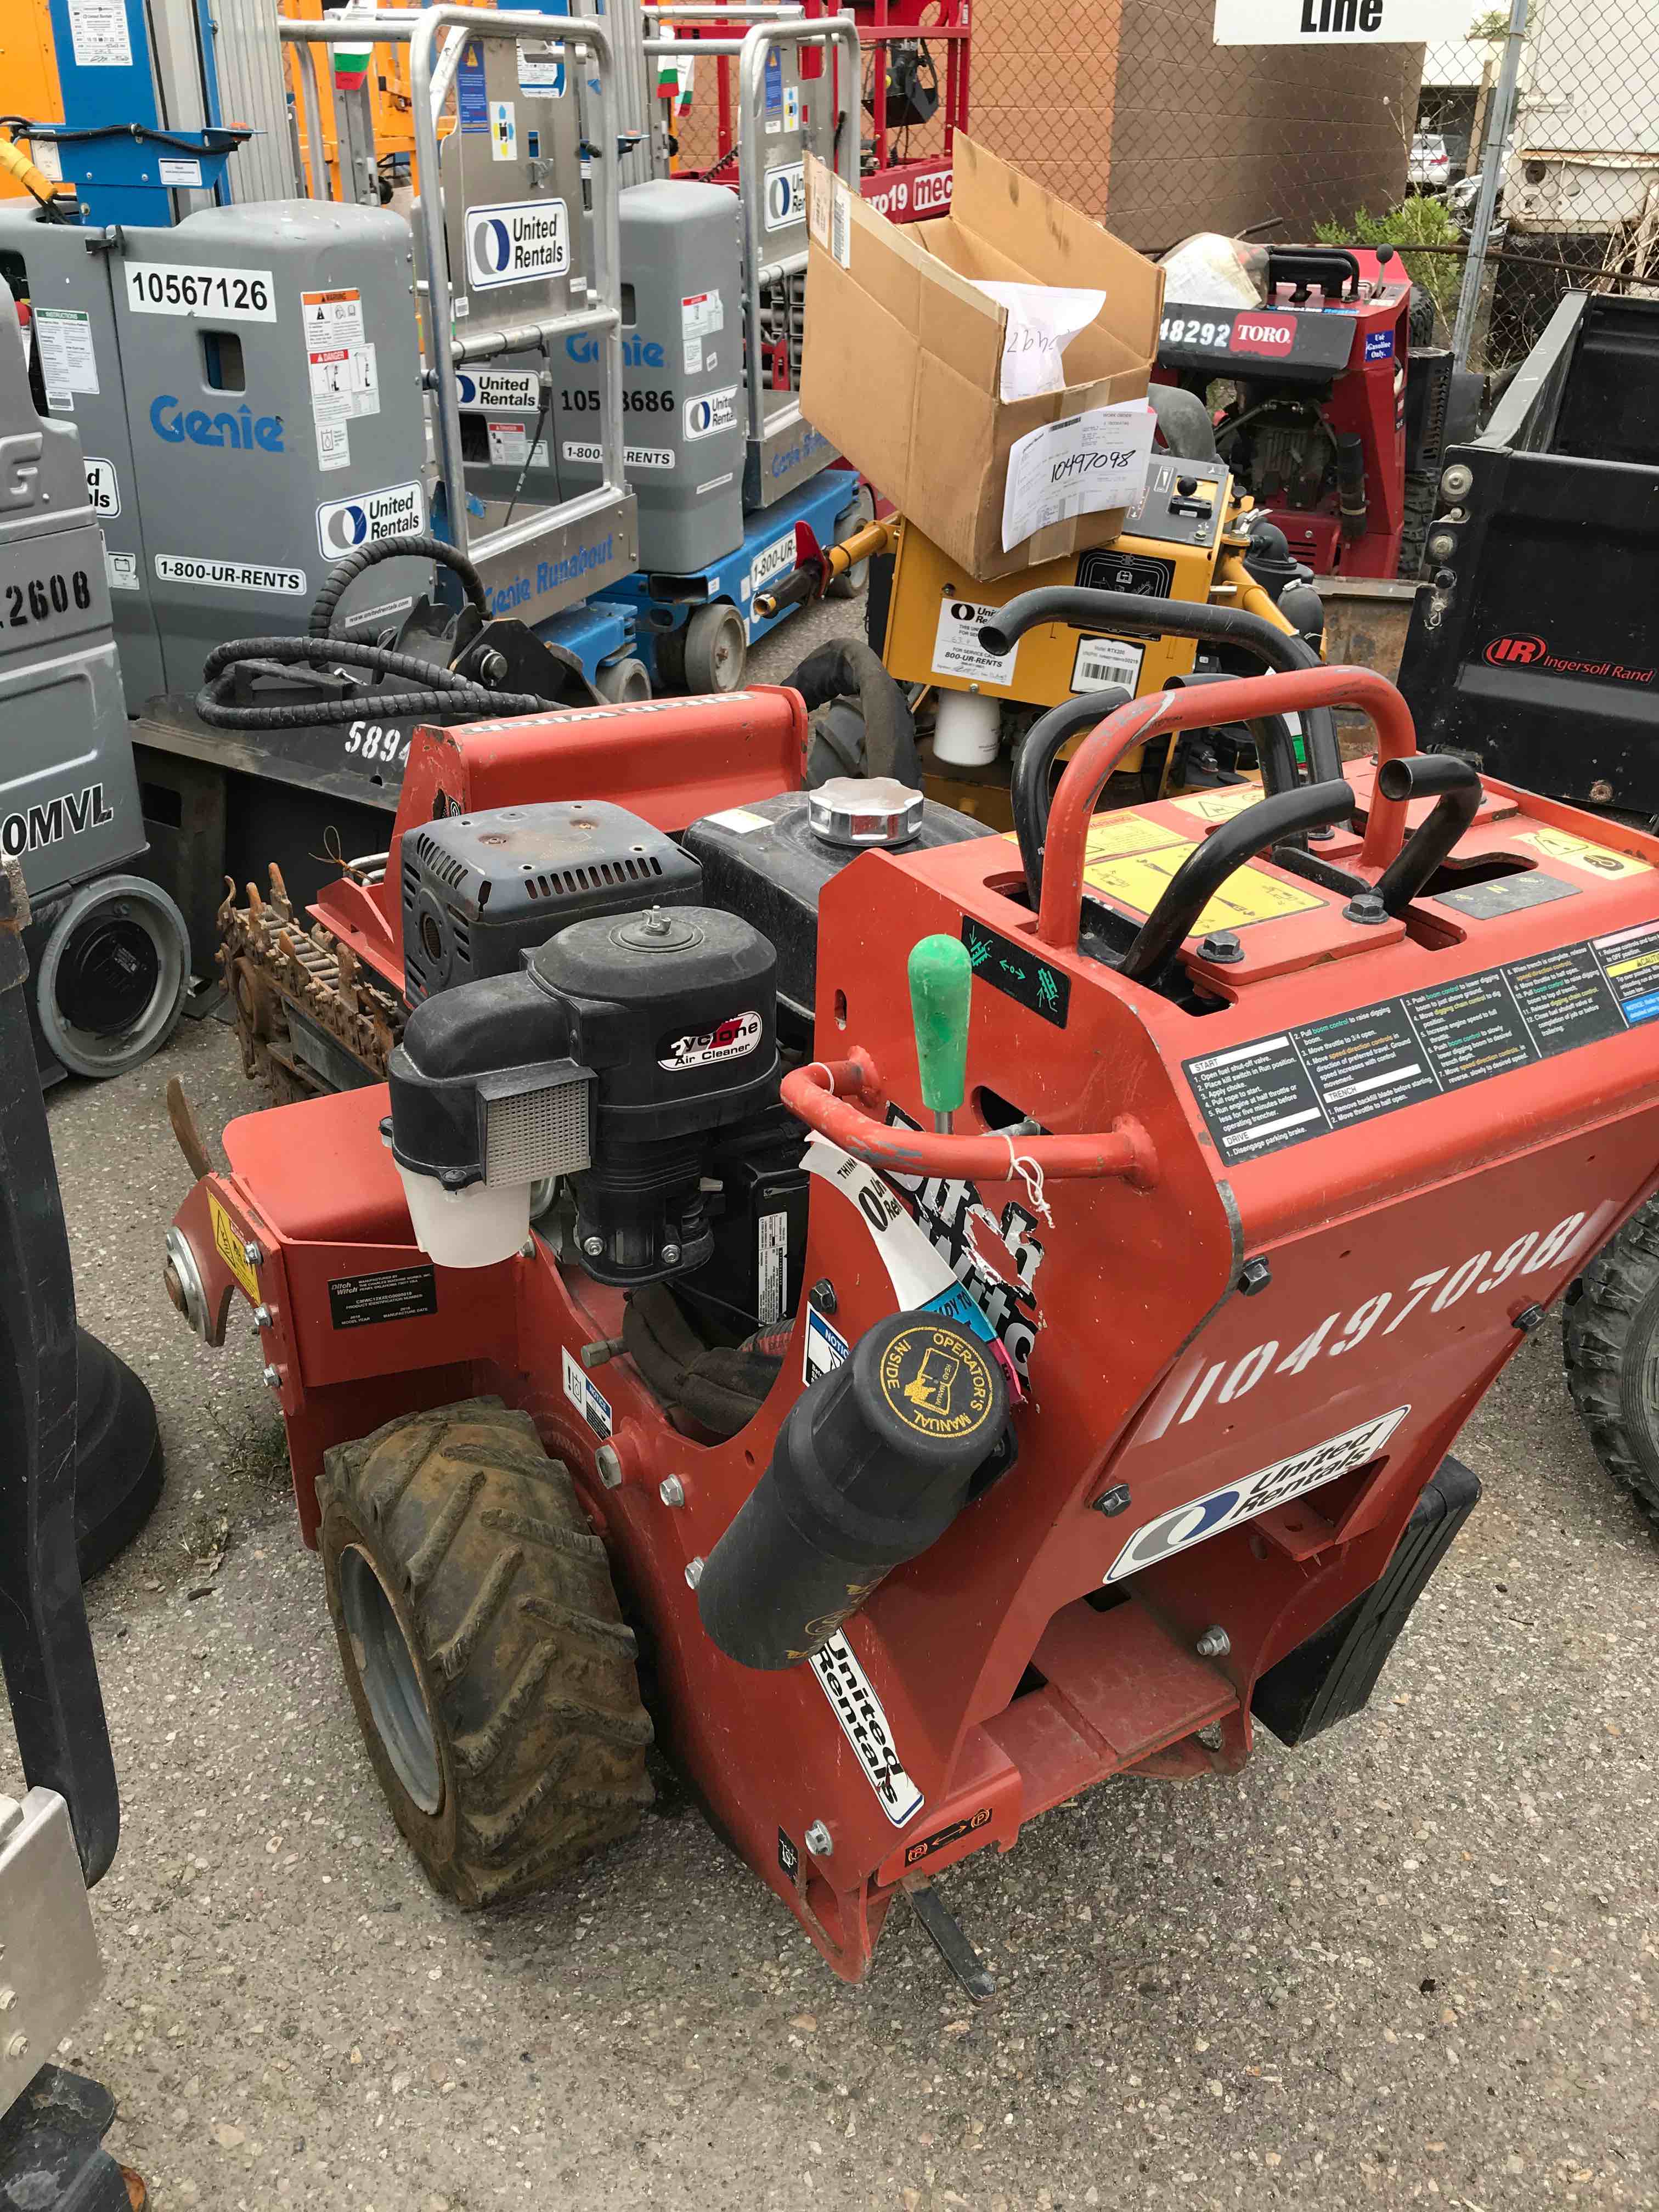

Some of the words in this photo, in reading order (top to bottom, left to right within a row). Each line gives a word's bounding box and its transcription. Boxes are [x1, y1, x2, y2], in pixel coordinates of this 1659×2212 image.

[1300, 0, 1383, 33] Line
[513, 214, 557, 242] United
[515, 240, 563, 269] Rentals
[132, 271, 268, 311] 10567126
[1237, 324, 1290, 344] TORO
[1368, 341, 1391, 351] Gasoline
[322, 350, 345, 361] DANGER
[1371, 351, 1386, 359] Only.
[479, 376, 529, 391] United
[480, 391, 535, 406] Rentals
[712, 396, 733, 411] Unit
[150, 394, 285, 453] Genie
[712, 411, 736, 426] Renta
[567, 447, 670, 465] 1-800--RENTS
[1051, 449, 1136, 483] 10497098
[369, 492, 415, 522] United
[371, 510, 419, 540] Rentals
[536, 533, 614, 594] Runabout
[754, 539, 795, 580] 1-800-UR-
[160, 560, 300, 590] 1-800-UR-RENTS
[0, 571, 91, 628] 2608
[977, 607, 996, 617] Uni
[945, 651, 1003, 668] 800-UR-RENTS
[1495, 639, 1536, 663] IR
[1542, 655, 1609, 678] Ingersoll
[1610, 664, 1654, 683] Rand
[623, 694, 752, 714] Ditch
[674, 1020, 758, 1053] yclone
[1303, 1035, 1322, 1045] boom.
[675, 1054, 696, 1066] Air
[702, 1042, 751, 1060] Cleaner
[1194, 1058, 1220, 1071] START
[1199, 1070, 1218, 1082] Open
[1217, 1066, 1231, 1076] fuel
[1229, 1059, 1254, 1072] shut-off
[1252, 1054, 1271, 1065] valve.
[1204, 1079, 1222, 1090] Place
[1221, 1076, 1232, 1084] kill
[1231, 1069, 1251, 1081] switch
[1257, 1063, 1271, 1073] Run
[1271, 1056, 1297, 1070] position.
[1323, 1074, 1354, 1088] movement.
[1207, 1087, 1227, 1099] Apply
[1226, 1081, 1246, 1092] choke.
[1211, 1097, 1224, 1107] Pull
[1223, 1092, 1240, 1103] rope
[1245, 1085, 1262, 1095] start.
[1215, 1105, 1229, 1115] Run
[1228, 1099, 1250, 1111] engine
[1256, 1092, 1269, 1102] half
[1267, 1086, 1290, 1098] throttle
[1328, 1086, 1357, 1100] TRENCH
[1333, 1101, 1357, 1113] Remove
[1356, 1093, 1378, 1105] backfill
[1377, 1088, 1393, 1098] blade
[1392, 1082, 1412, 1093] before
[1218, 1114, 1233, 1123] less
[1232, 1110, 1242, 1119] for
[1241, 1107, 1254, 1116] five
[1253, 1099, 1278, 1112] minutes
[1277, 1093, 1297, 1104] before
[1222, 1117, 1252, 1133] operating
[1251, 1108, 1279, 1122] trencher.
[1226, 1132, 1249, 1144] DRIVE
[1232, 1139, 1266, 1156] Disengage
[1264, 1131, 1289, 1146] parking
[1287, 1125, 1307, 1137] brake.
[331, 1282, 351, 1290] Ditch
[337, 1286, 358, 1295] Witch
[368, 1297, 403, 1307] IDENTIFICATION
[383, 1310, 416, 1318] MANUFACTURE
[934, 1298, 960, 1317] ADY
[957, 1291, 973, 1311] TO
[1178, 1212, 1586, 1424] 10497098
[825, 1329, 850, 1359] NOTIC
[886, 1339, 912, 1390] INSIDE
[933, 1332, 986, 1412] OPERATOR'S
[589, 1385, 607, 1412] NOTICE
[913, 1408, 973, 1432] MANUAL
[1253, 1421, 1386, 1494] United
[1231, 1446, 1372, 1522] Rentals
[823, 1637, 905, 1775] United
[817, 1650, 898, 1806] Rentals
